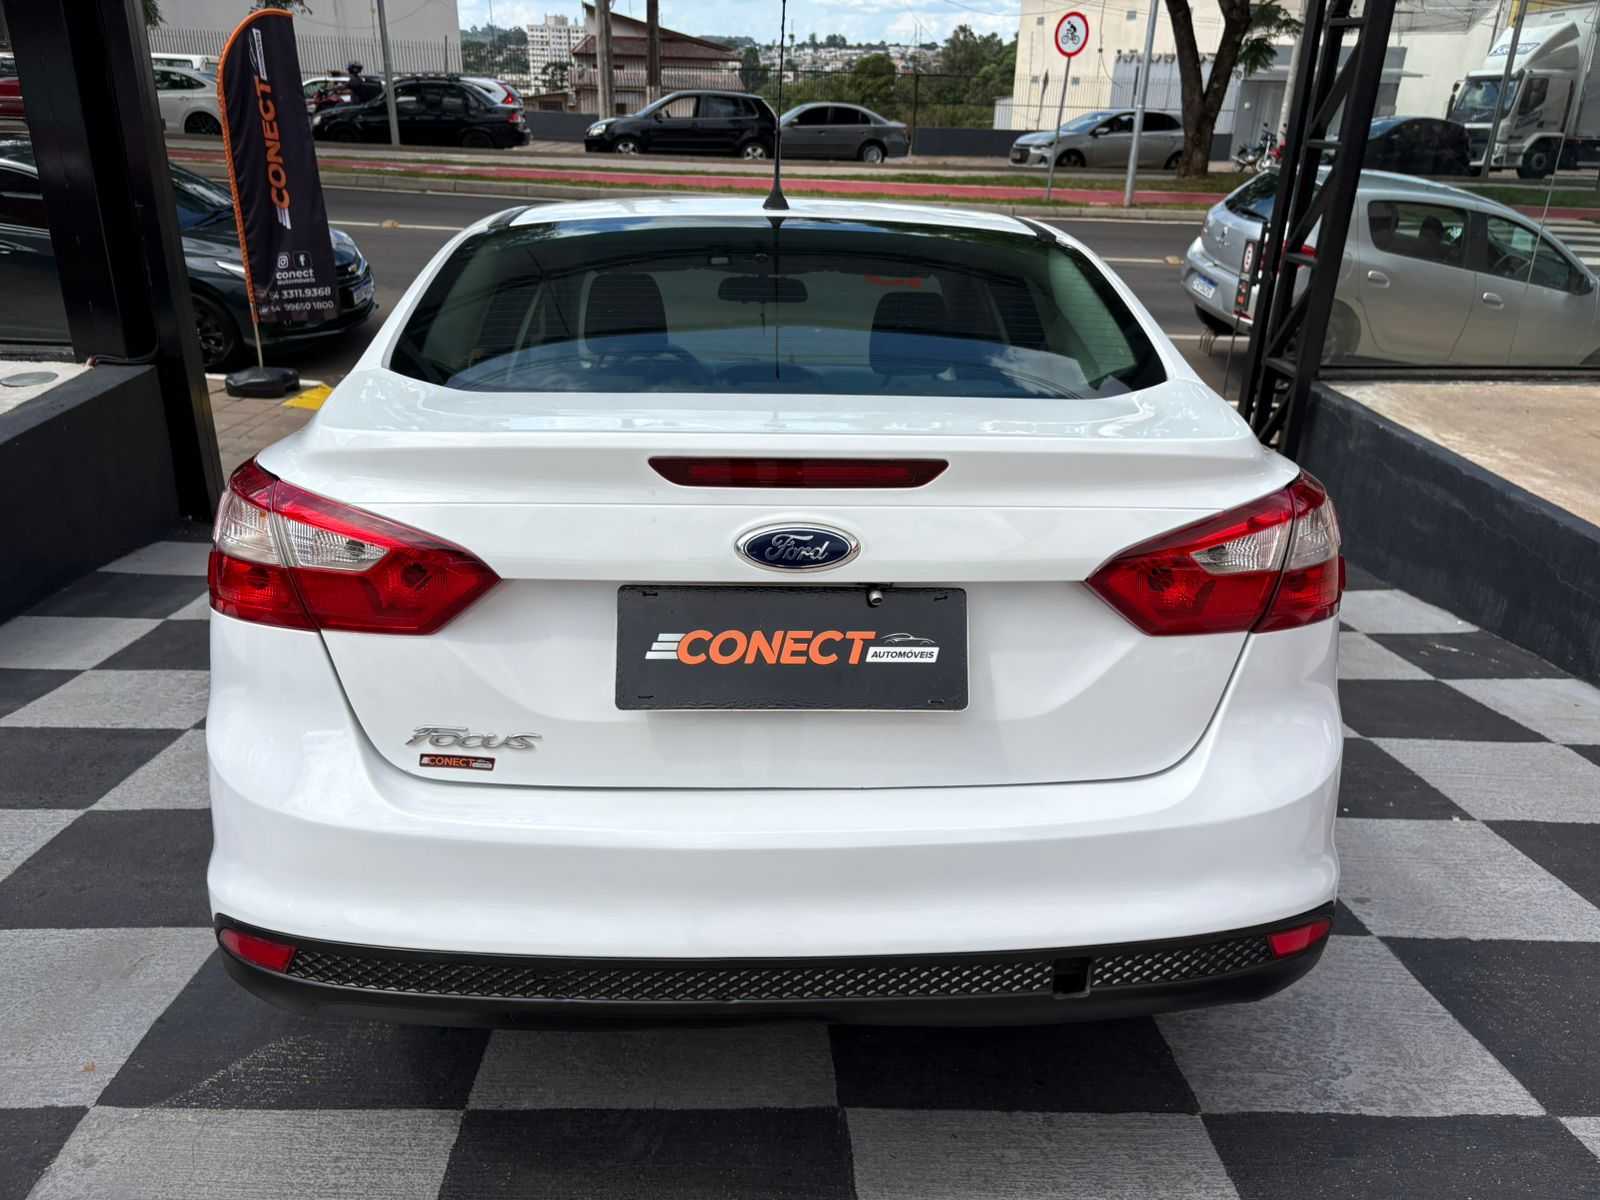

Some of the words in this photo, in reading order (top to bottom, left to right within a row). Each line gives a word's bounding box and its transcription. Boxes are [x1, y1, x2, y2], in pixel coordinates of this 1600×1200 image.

[254, 76, 291, 209] CONECT
[276, 269, 313, 279] conect
[282, 287, 331, 299] 3311.9368
[764, 533, 828, 562] Ford
[676, 629, 878, 665] CONECT
[870, 647, 935, 660] AUTOMÓVEIS
[430, 756, 474, 768] CONECT
